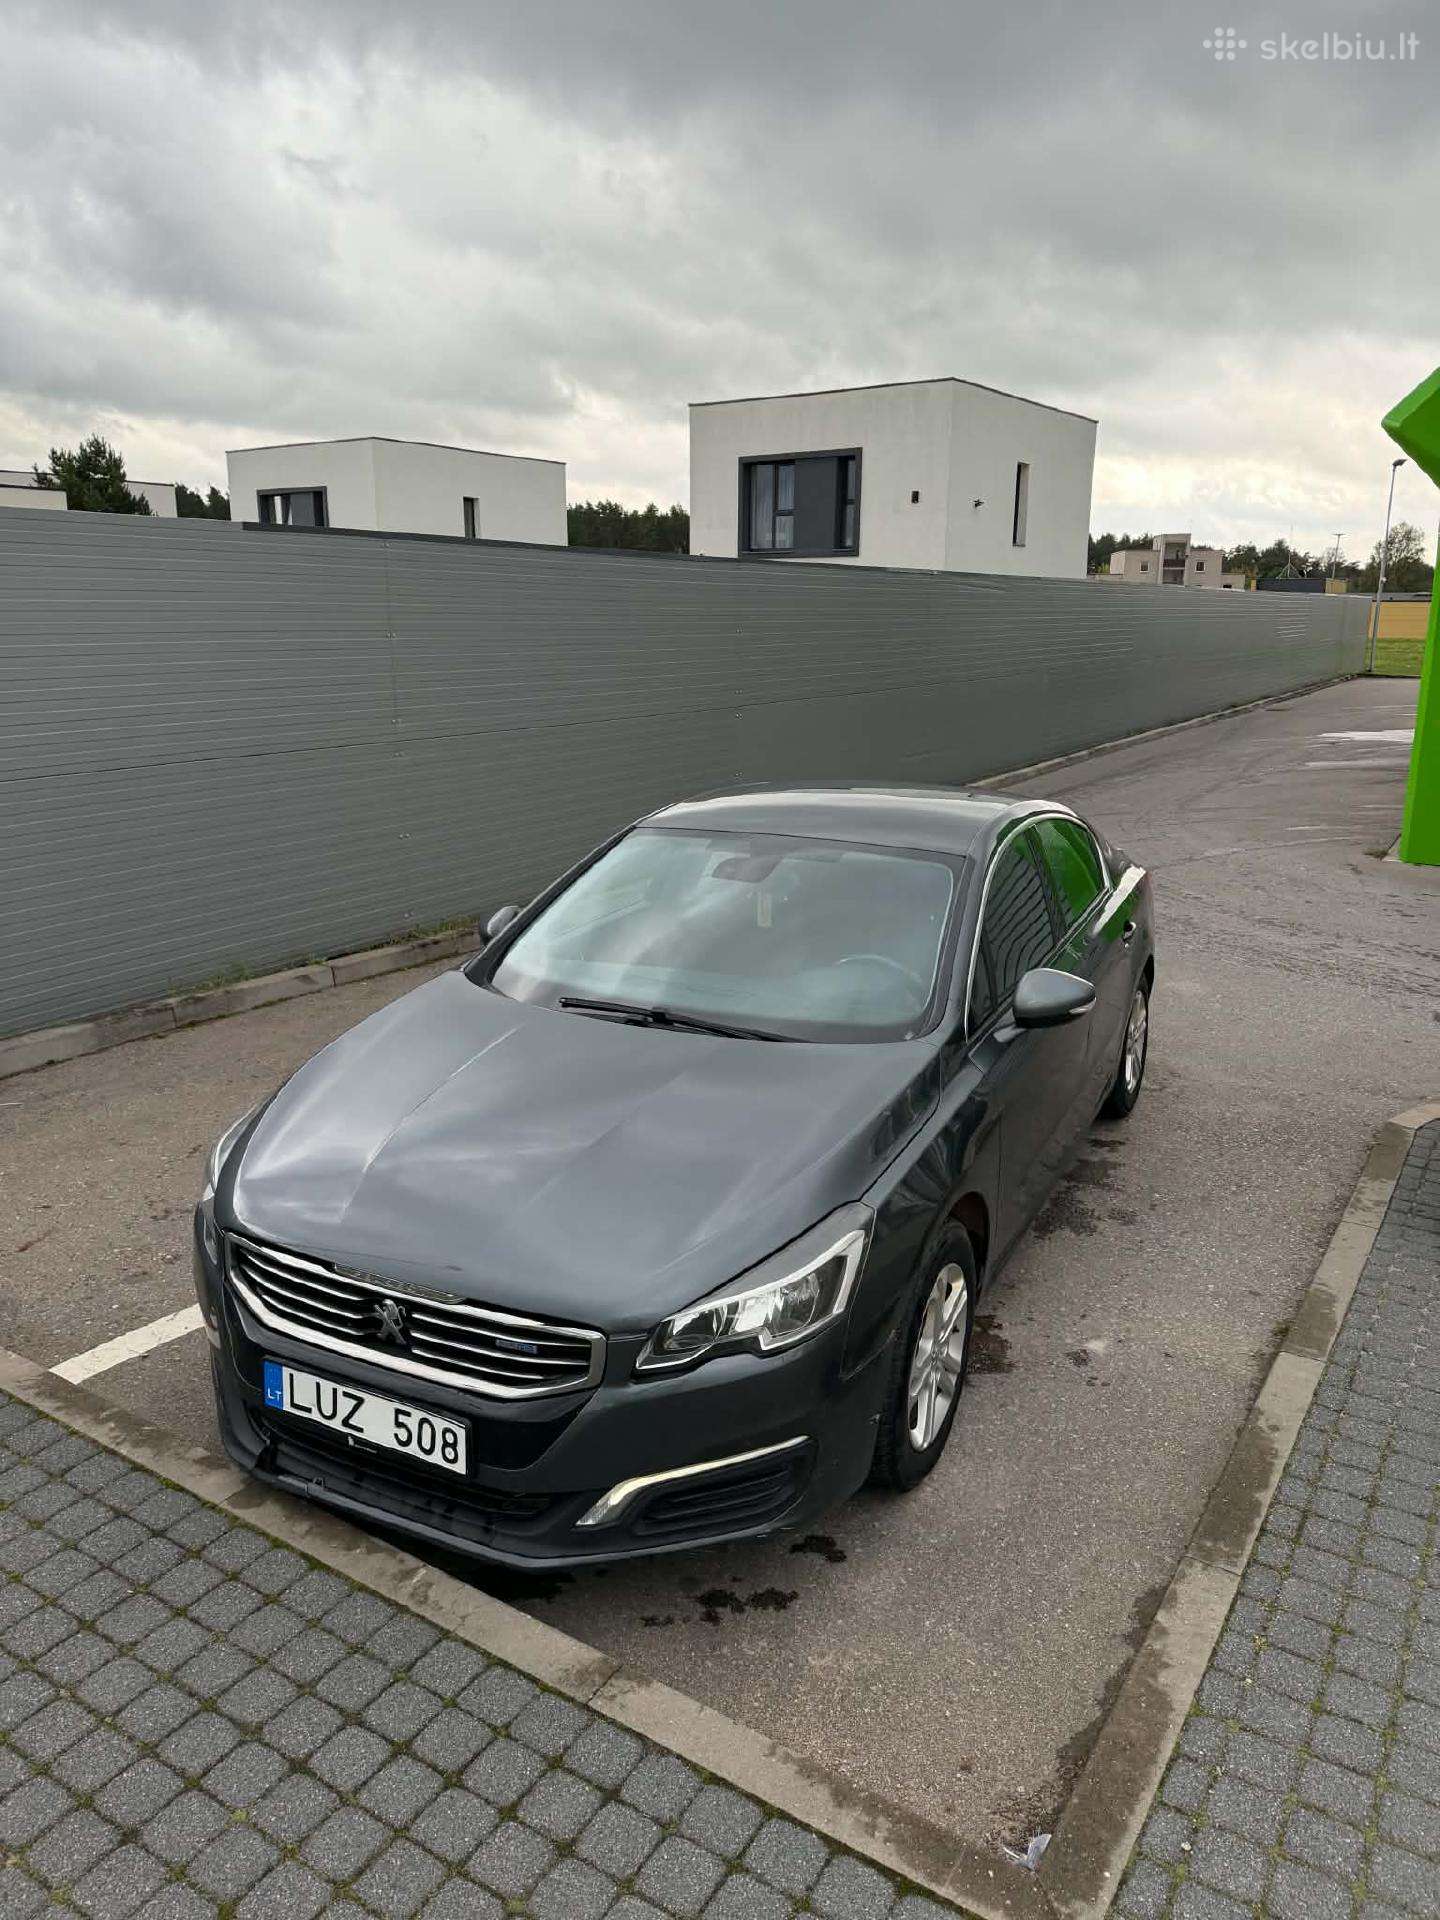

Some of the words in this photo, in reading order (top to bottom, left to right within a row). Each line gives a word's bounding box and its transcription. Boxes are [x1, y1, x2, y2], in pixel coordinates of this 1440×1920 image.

[267, 1387, 282, 1401] LT
[289, 1372, 365, 1433] LUZ
[393, 1407, 459, 1465] 508
